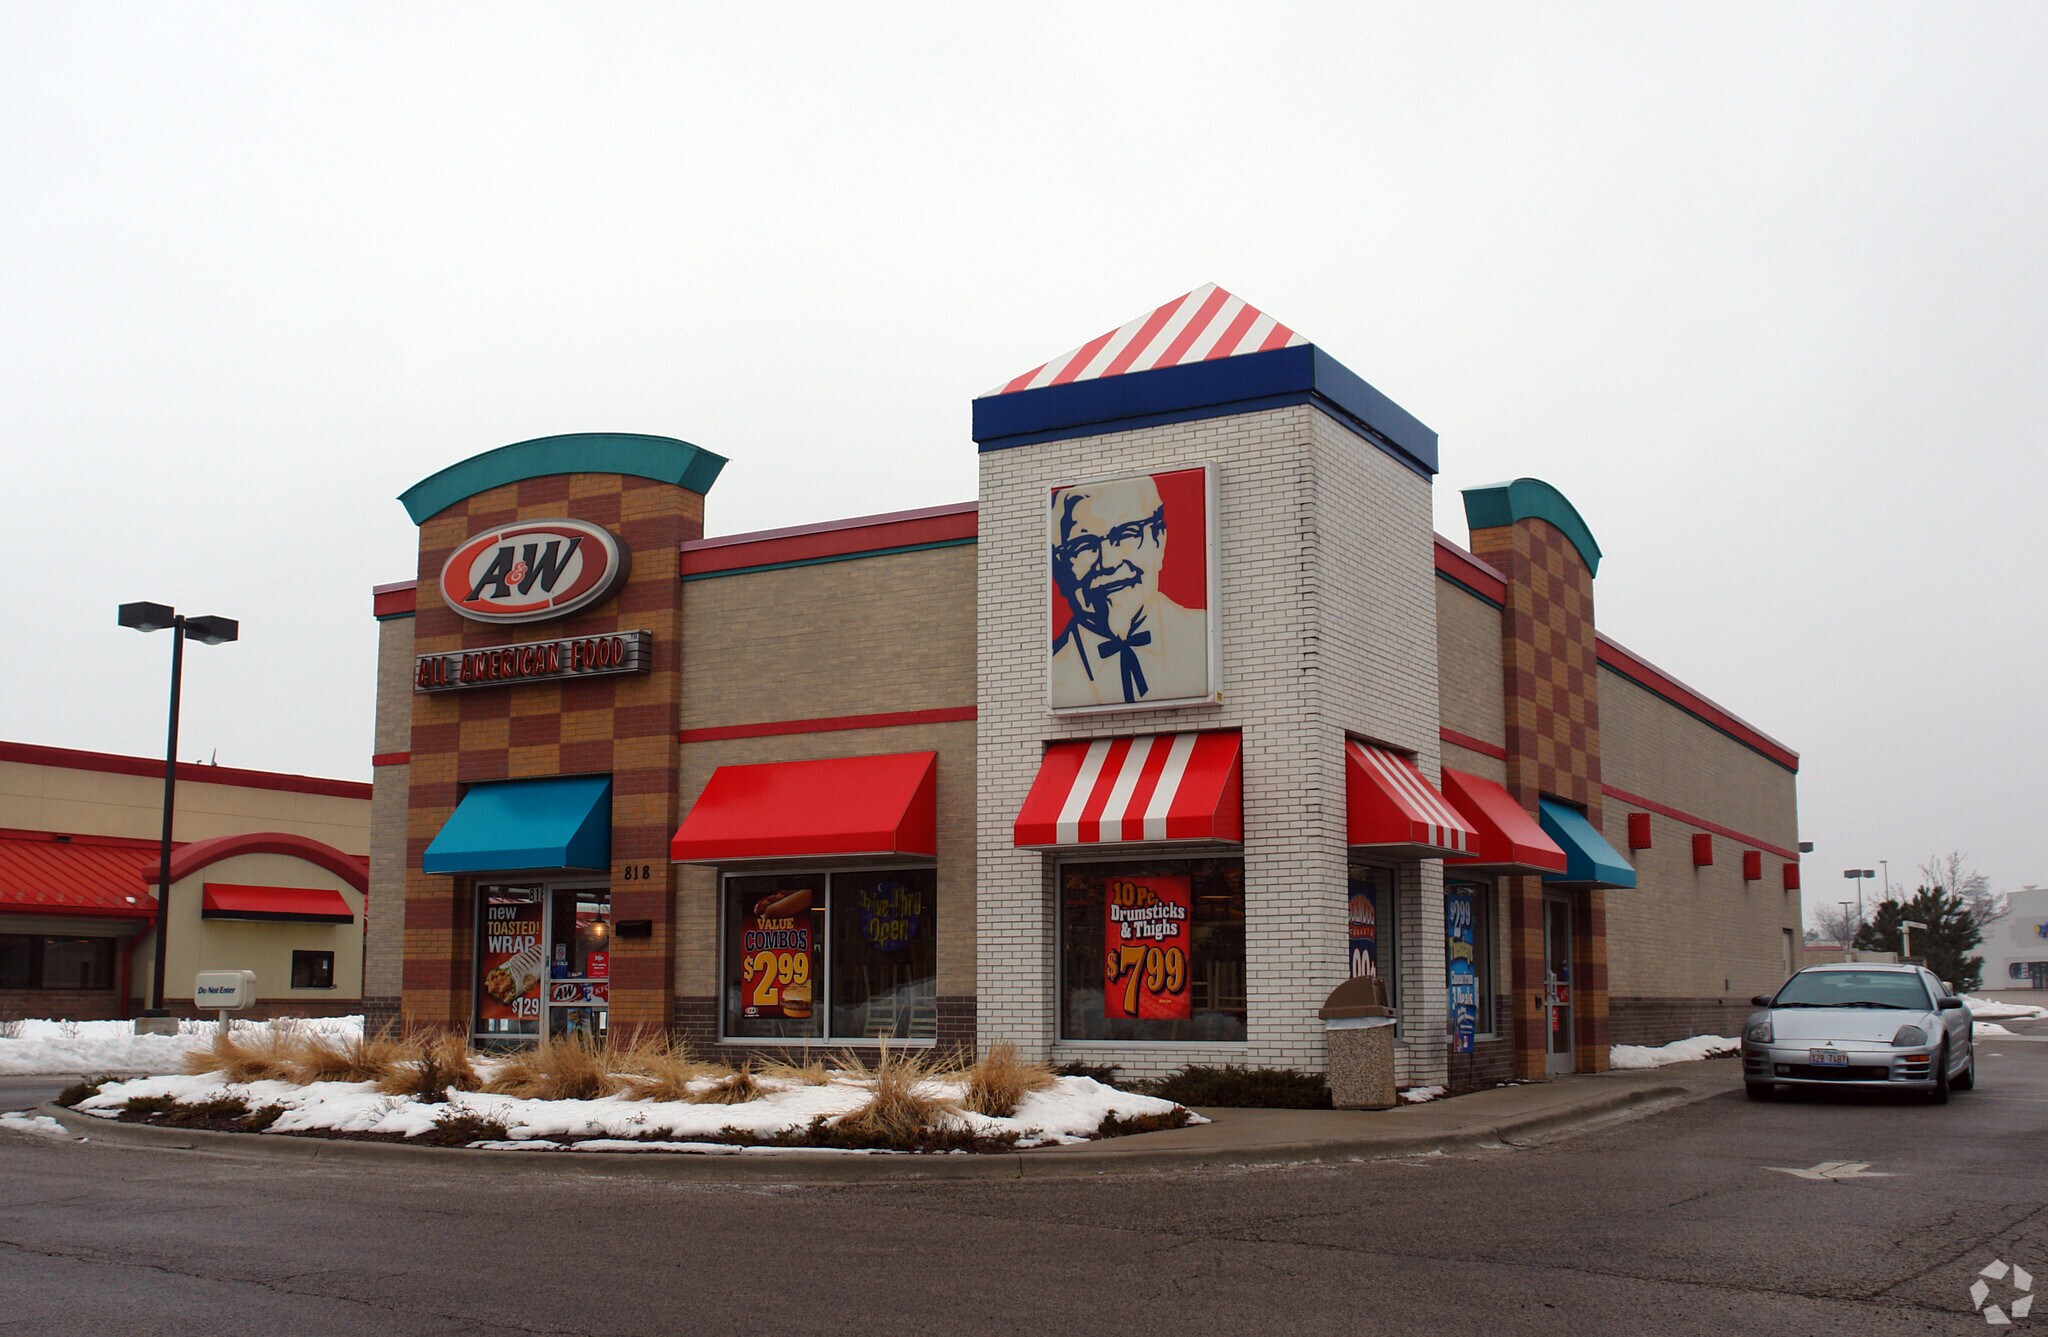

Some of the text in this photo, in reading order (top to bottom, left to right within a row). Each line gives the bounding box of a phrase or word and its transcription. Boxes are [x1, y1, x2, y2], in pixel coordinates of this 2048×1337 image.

[464, 536, 583, 602] A&W
[417, 656, 448, 688] ALL
[459, 642, 560, 683] AMERICAN
[570, 636, 624, 671] FOOD
[625, 865, 650, 880] 818
[1113, 881, 1135, 906] 10
[489, 906, 517, 920] new
[1110, 902, 1185, 921] Drumsticks
[487, 921, 540, 935] TOASTED!
[757, 917, 794, 930] VALUE
[868, 917, 909, 948] Open
[1120, 919, 1178, 940] & Thighs
[488, 935, 536, 954] WRAP
[745, 929, 807, 952] COMBOS
[197, 986, 236, 994] Do Not Enter
